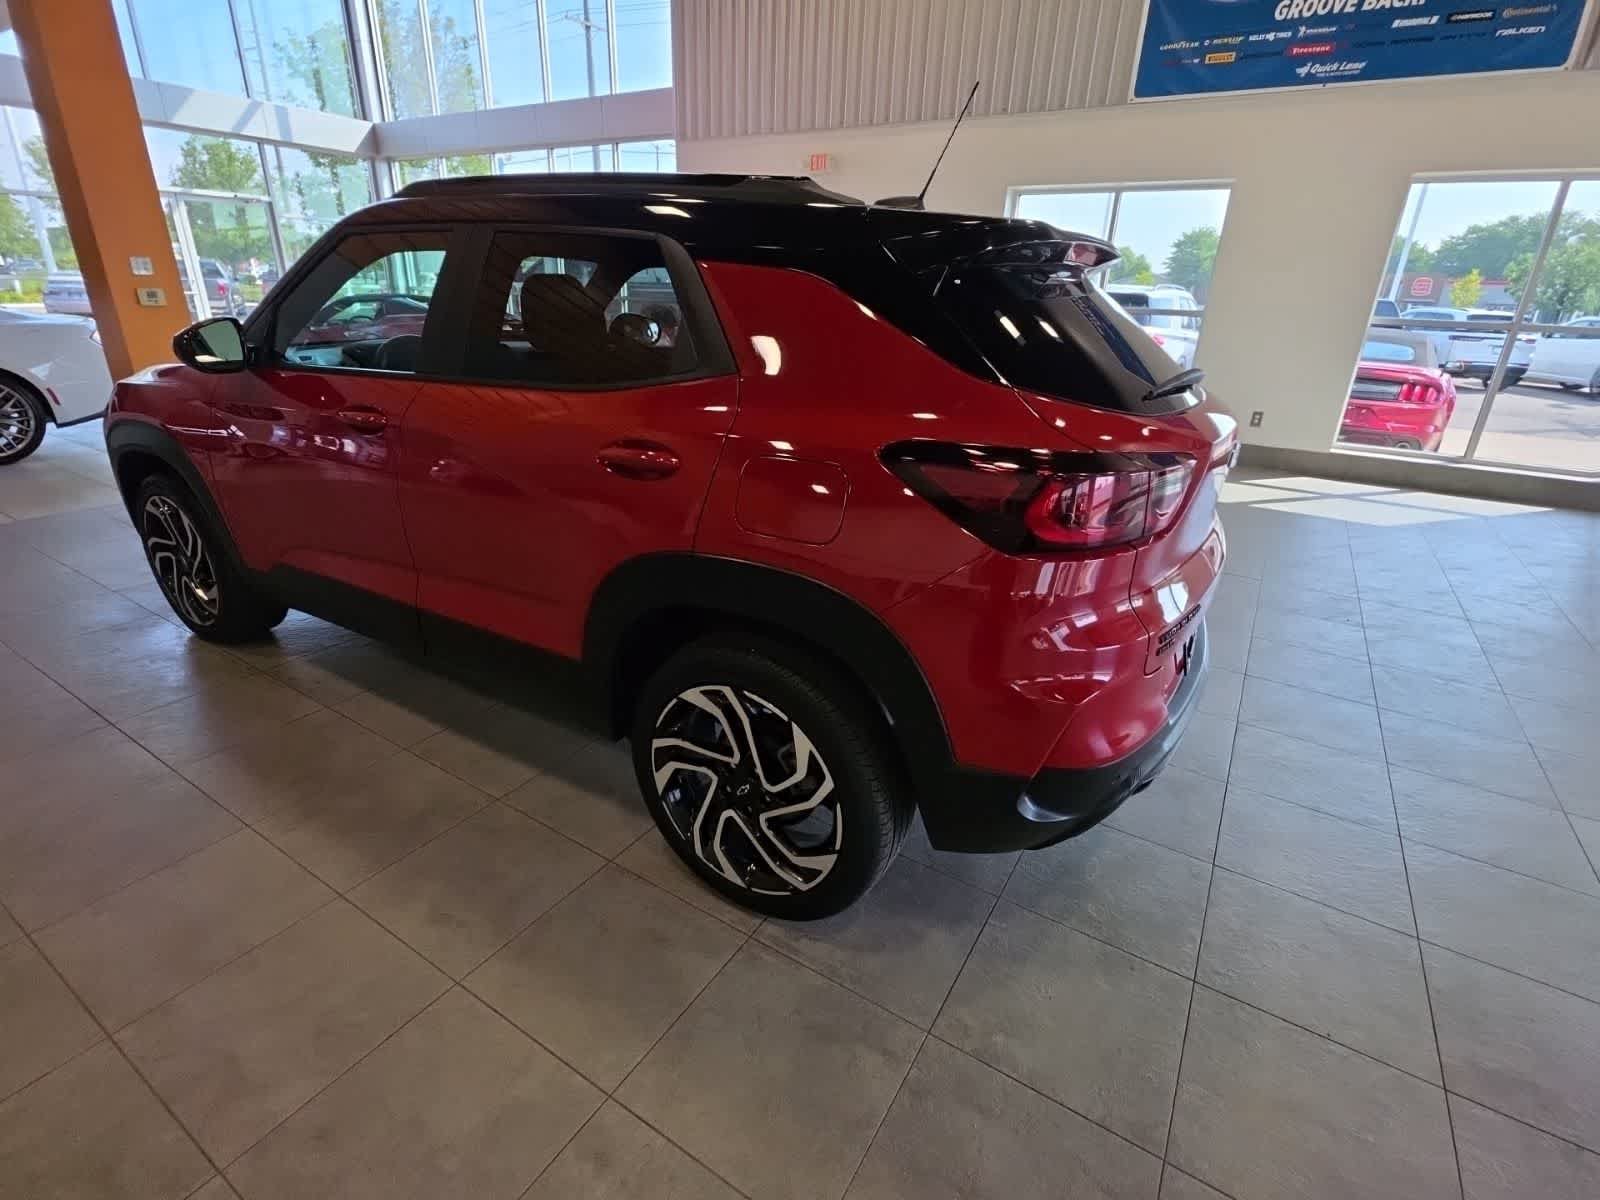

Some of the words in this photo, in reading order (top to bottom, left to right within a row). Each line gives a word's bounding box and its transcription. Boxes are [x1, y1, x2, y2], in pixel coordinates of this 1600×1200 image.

[1274, 0, 1357, 20] GROOVE
[1496, 26, 1545, 36] FALKEN
[1292, 45, 1331, 54] Firestone
[1311, 62, 1338, 73] Quick
